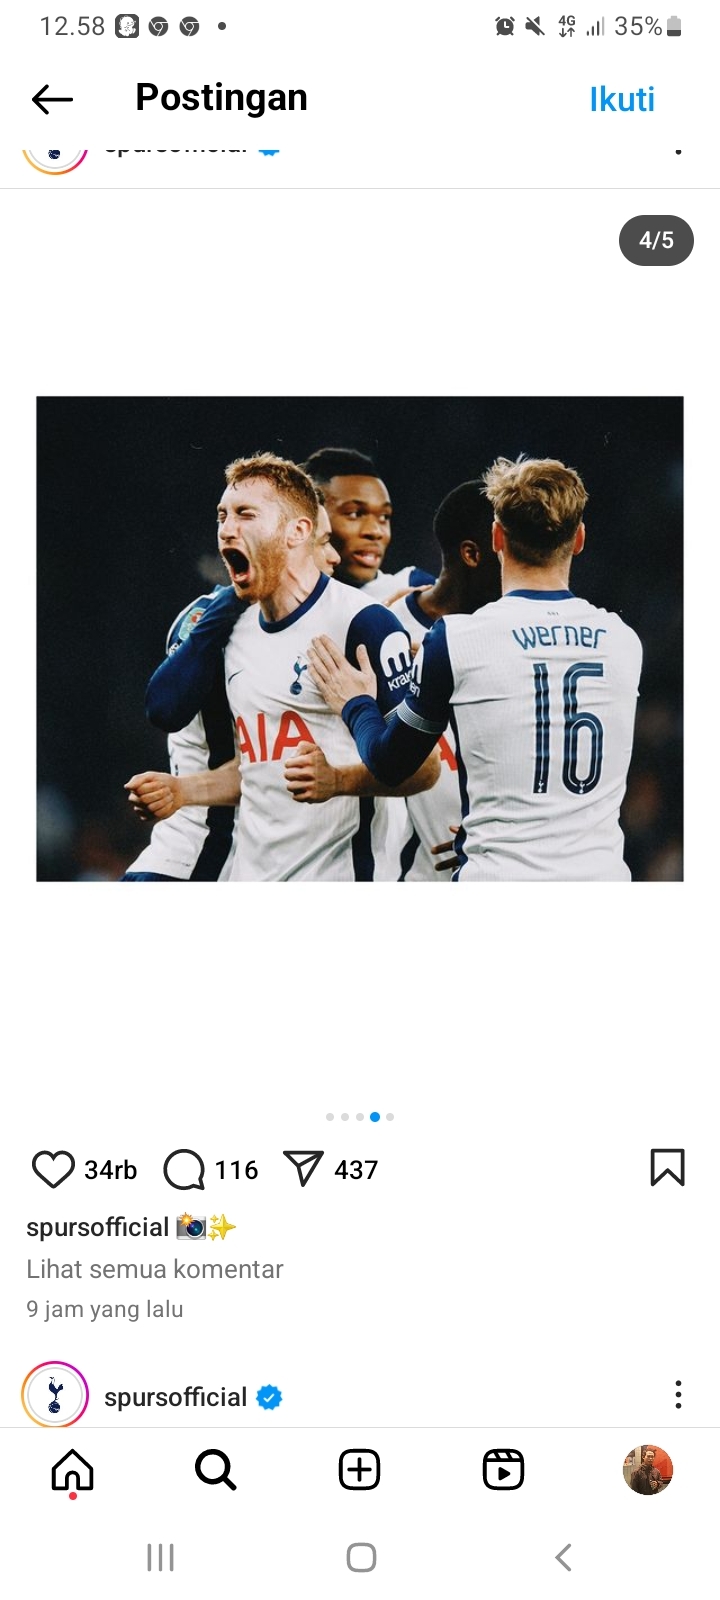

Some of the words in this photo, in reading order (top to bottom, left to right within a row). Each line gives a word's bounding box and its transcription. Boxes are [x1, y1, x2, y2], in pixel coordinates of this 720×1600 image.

[41, 16, 105, 36] 12.58
[558, 15, 576, 26] 4G
[614, 16, 663, 36] 35%
[136, 82, 308, 118] Postingan
[591, 85, 655, 112] Ikuti
[638, 231, 674, 249] 4/5
[512, 625, 607, 650] werner
[236, 710, 317, 763] AIA
[532, 662, 604, 794] 16
[84, 1159, 138, 1180] 34rb
[215, 1159, 259, 1180] 116
[334, 1159, 379, 1180] 437
[26, 1216, 169, 1242] spursofficial
[27, 1258, 83, 1279] Lihat
[90, 1263, 167, 1279] semua
[174, 1258, 285, 1279] komentar
[26, 1300, 38, 1318] 9
[43, 1300, 84, 1323] jam
[90, 1304, 139, 1323] yang
[147, 1300, 184, 1318] lalu
[104, 1386, 247, 1412] spursofficial
